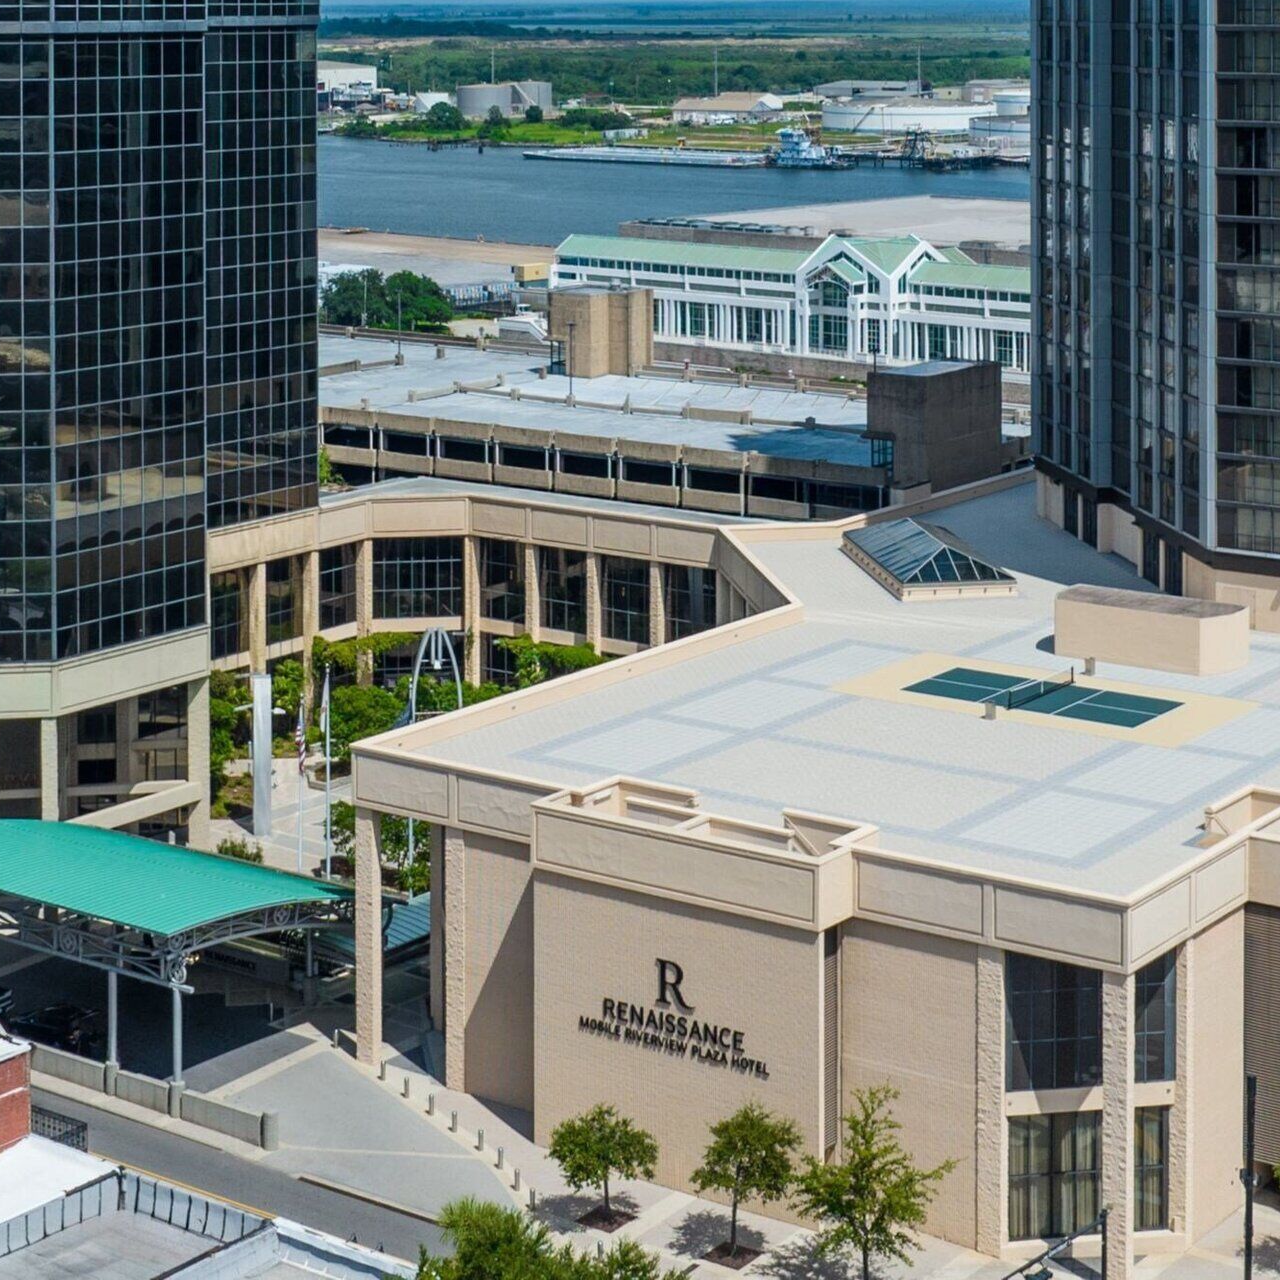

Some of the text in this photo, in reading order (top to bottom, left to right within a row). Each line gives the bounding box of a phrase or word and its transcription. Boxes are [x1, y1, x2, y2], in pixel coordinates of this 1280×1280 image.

[655, 957, 695, 1011] R
[579, 1015, 770, 1077] MOBILE RIVERVIEW PLAZA HOTEL
[602, 997, 746, 1053] RENAISSANCE
